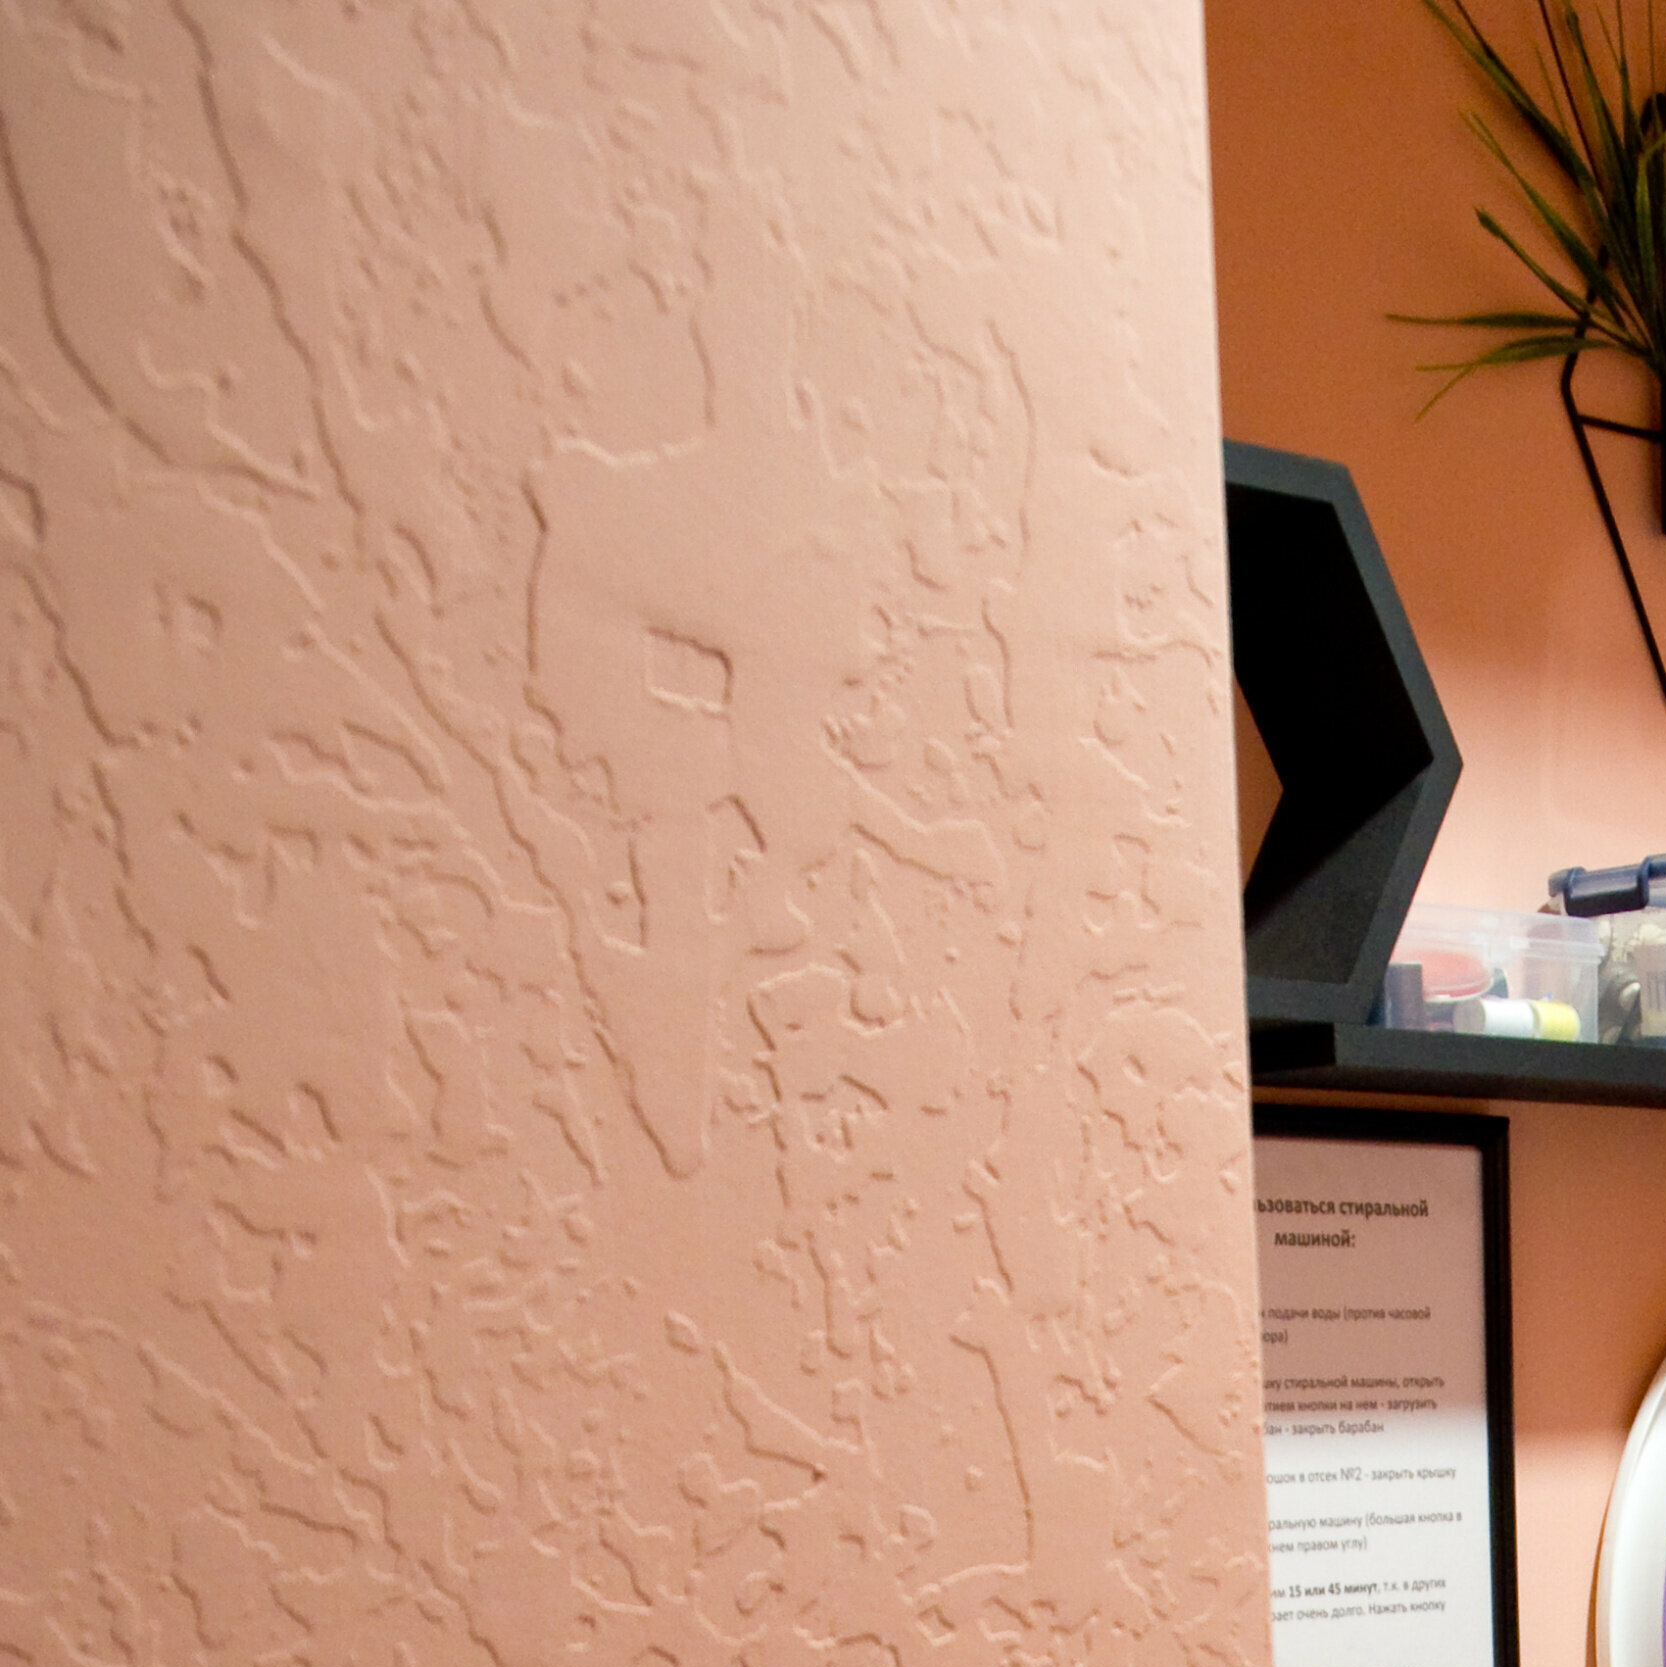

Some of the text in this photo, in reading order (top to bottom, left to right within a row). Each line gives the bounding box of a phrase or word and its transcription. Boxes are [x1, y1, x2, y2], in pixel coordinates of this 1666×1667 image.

[1339, 1200, 1429, 1219] стиральной
[1274, 1230, 1356, 1248] машиной:
[1284, 1376, 1348, 1390] стиральной
[1402, 1376, 1446, 1388] открыть
[1292, 1423, 1336, 1437] закрыть
[1338, 1420, 1384, 1436] барабан
[1300, 1474, 1305, 1482] в
[1308, 1472, 1338, 1482] отсек
[1340, 1467, 1362, 1481] №2
[1371, 1468, 1414, 1482] закрыть
[1416, 1468, 1456, 1480] крышку
[1319, 1516, 1362, 1528] машину
[1365, 1512, 1416, 1528] (большая
[1418, 1512, 1454, 1524] кнопка
[1296, 1540, 1338, 1553] правом
[1340, 1536, 1368, 1552] углу)
[1289, 1585, 1302, 1598] 15
[1304, 1586, 1326, 1597] или
[1328, 1582, 1342, 1595] 45
[1403, 1580, 1409, 1590] в
[1411, 1578, 1446, 1592] других
[1296, 1609, 1328, 1621] очень
[1368, 1602, 1408, 1615] Нажать
[1410, 1600, 1446, 1613] кнопку
